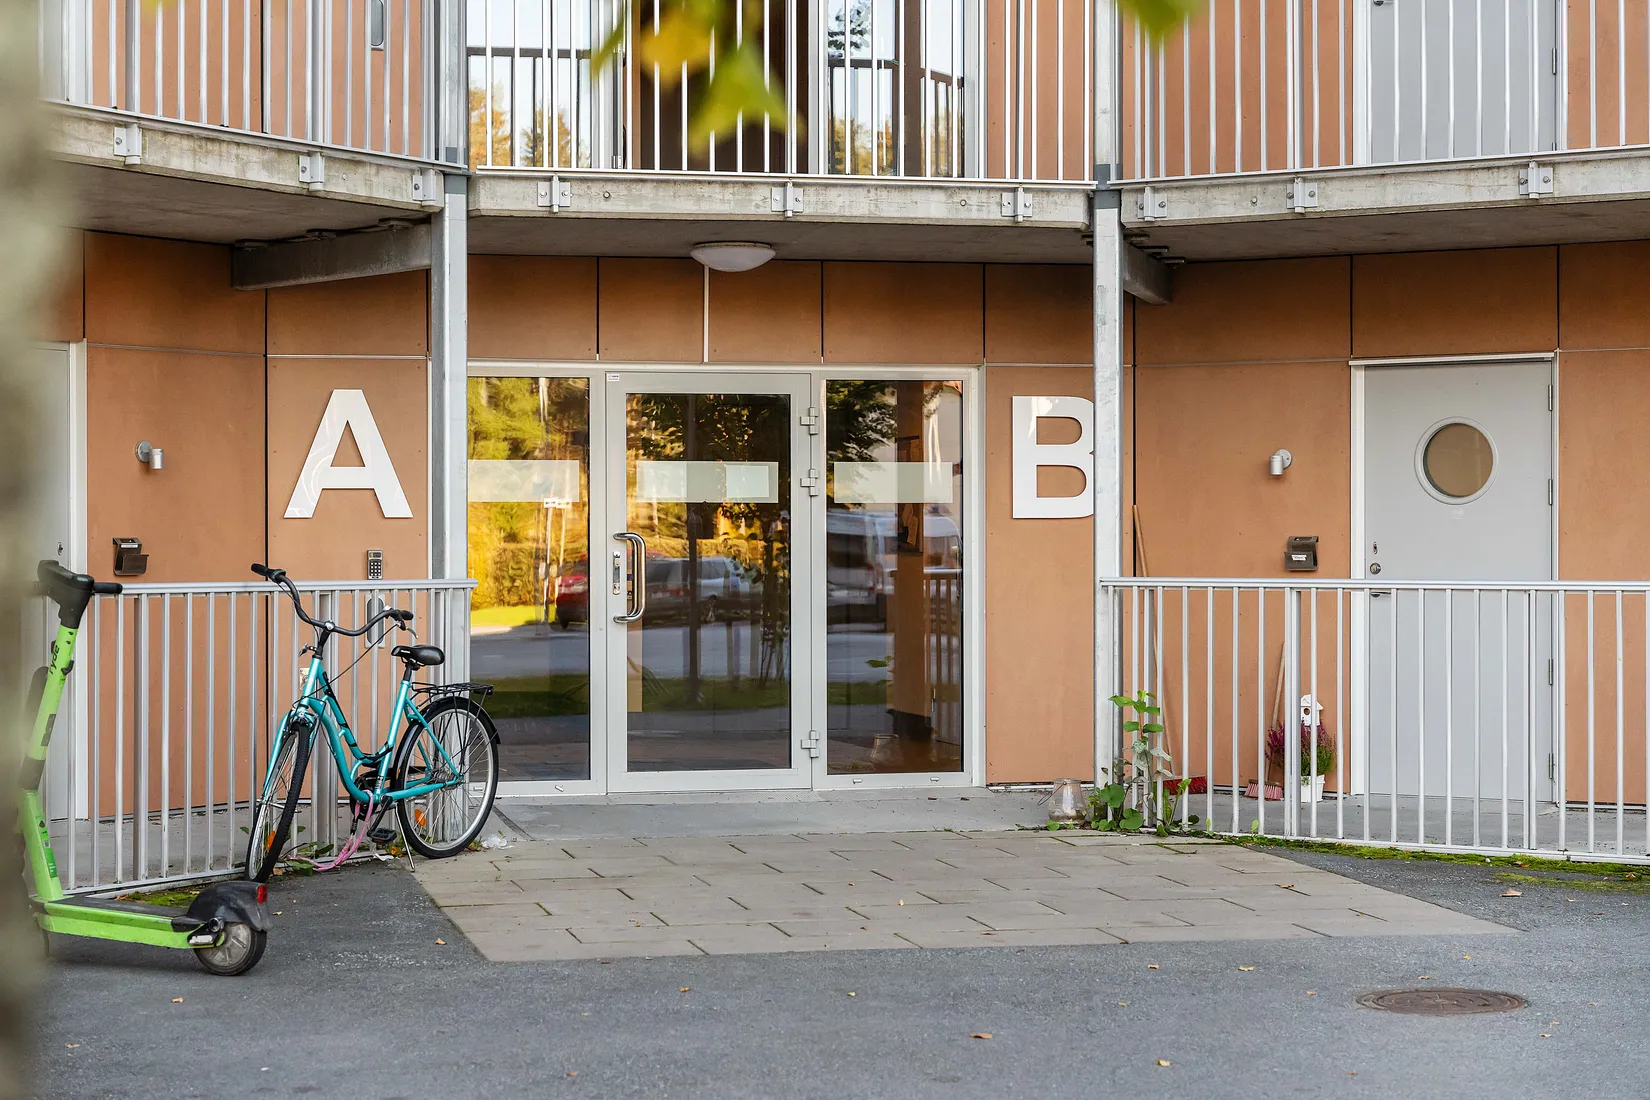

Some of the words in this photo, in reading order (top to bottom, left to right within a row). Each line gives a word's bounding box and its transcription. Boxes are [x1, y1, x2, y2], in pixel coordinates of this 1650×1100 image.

[284, 389, 414, 519] A
[1012, 396, 1095, 519] B
[49, 644, 60, 675] ryde
